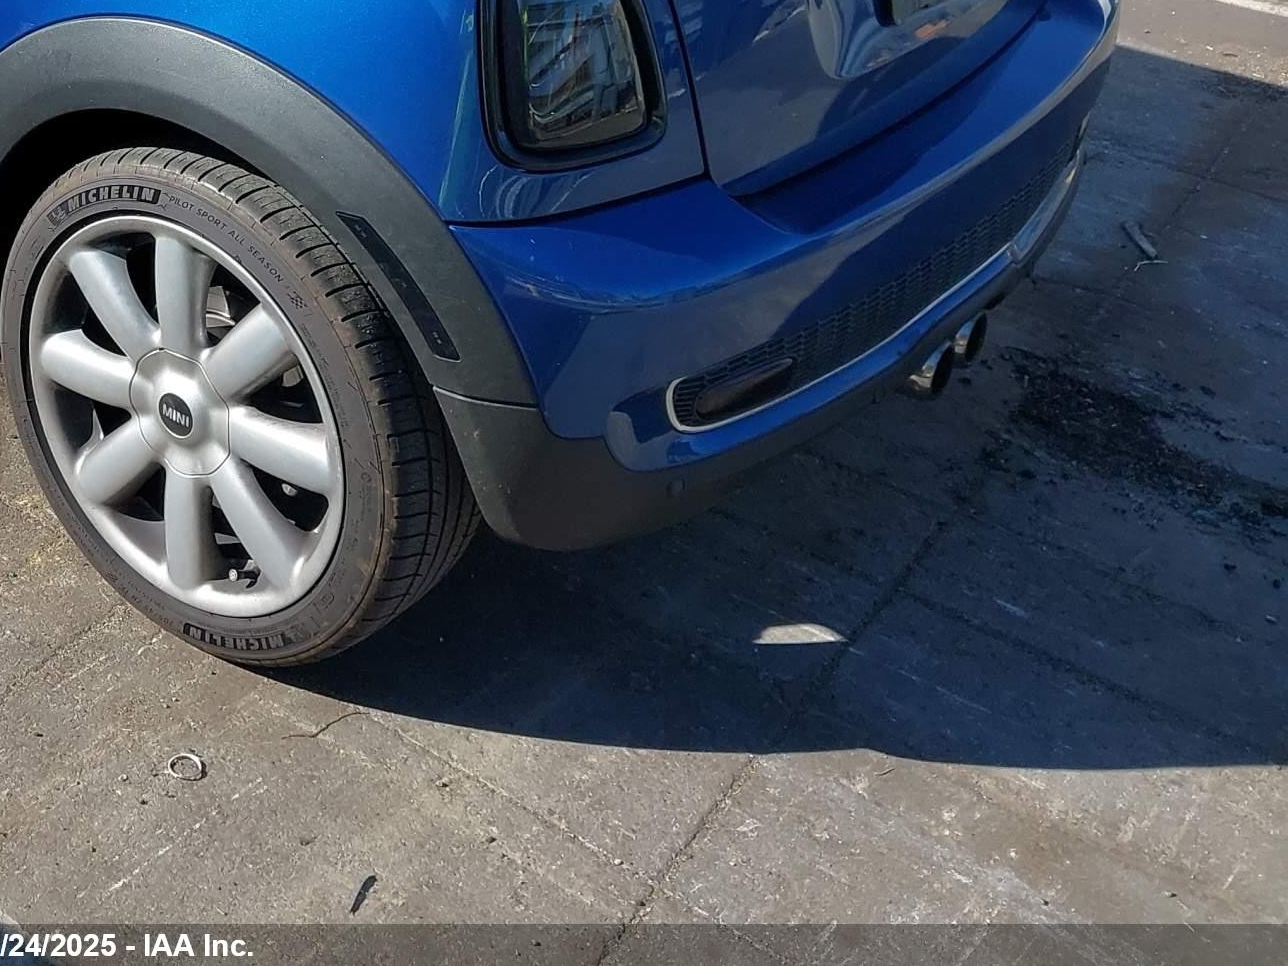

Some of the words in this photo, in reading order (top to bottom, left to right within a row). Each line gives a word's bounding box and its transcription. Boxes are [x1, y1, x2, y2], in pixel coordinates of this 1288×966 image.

[67, 185, 155, 212] MICHELIN
[168, 195, 194, 210] PILOT
[196, 208, 227, 230] SPORT
[228, 230, 246, 245] ALL
[248, 245, 284, 283] SEASON
[162, 403, 189, 428] MINI
[189, 625, 285, 651] MICHELIN
